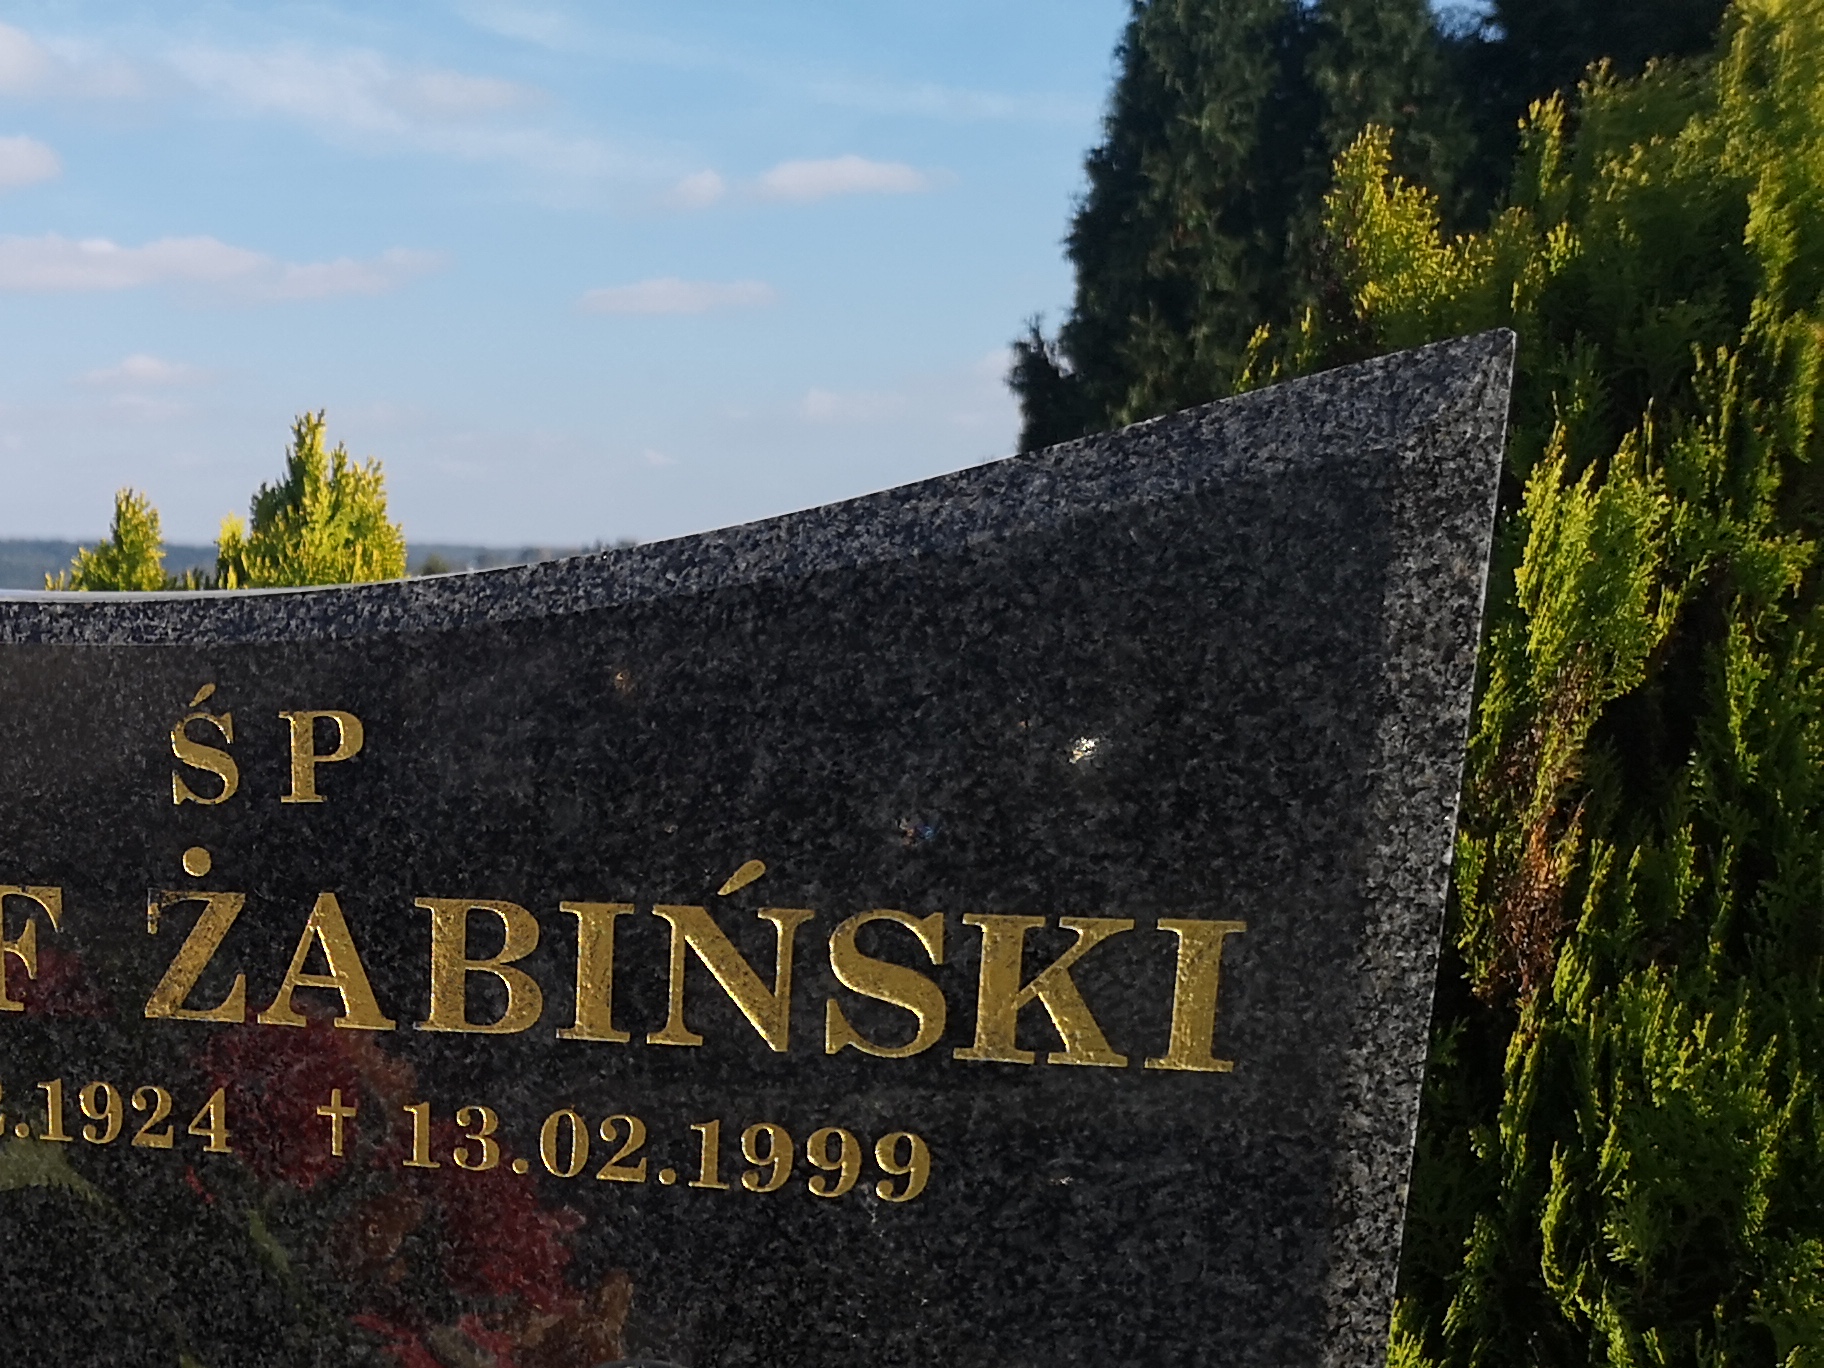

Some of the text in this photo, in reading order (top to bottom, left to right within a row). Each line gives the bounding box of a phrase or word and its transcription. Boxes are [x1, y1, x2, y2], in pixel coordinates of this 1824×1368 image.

[170, 682, 364, 805] Ś P
[144, 846, 1247, 1073] ŻABIŃSKI
[401, 1101, 932, 1203] 13.02.1999
